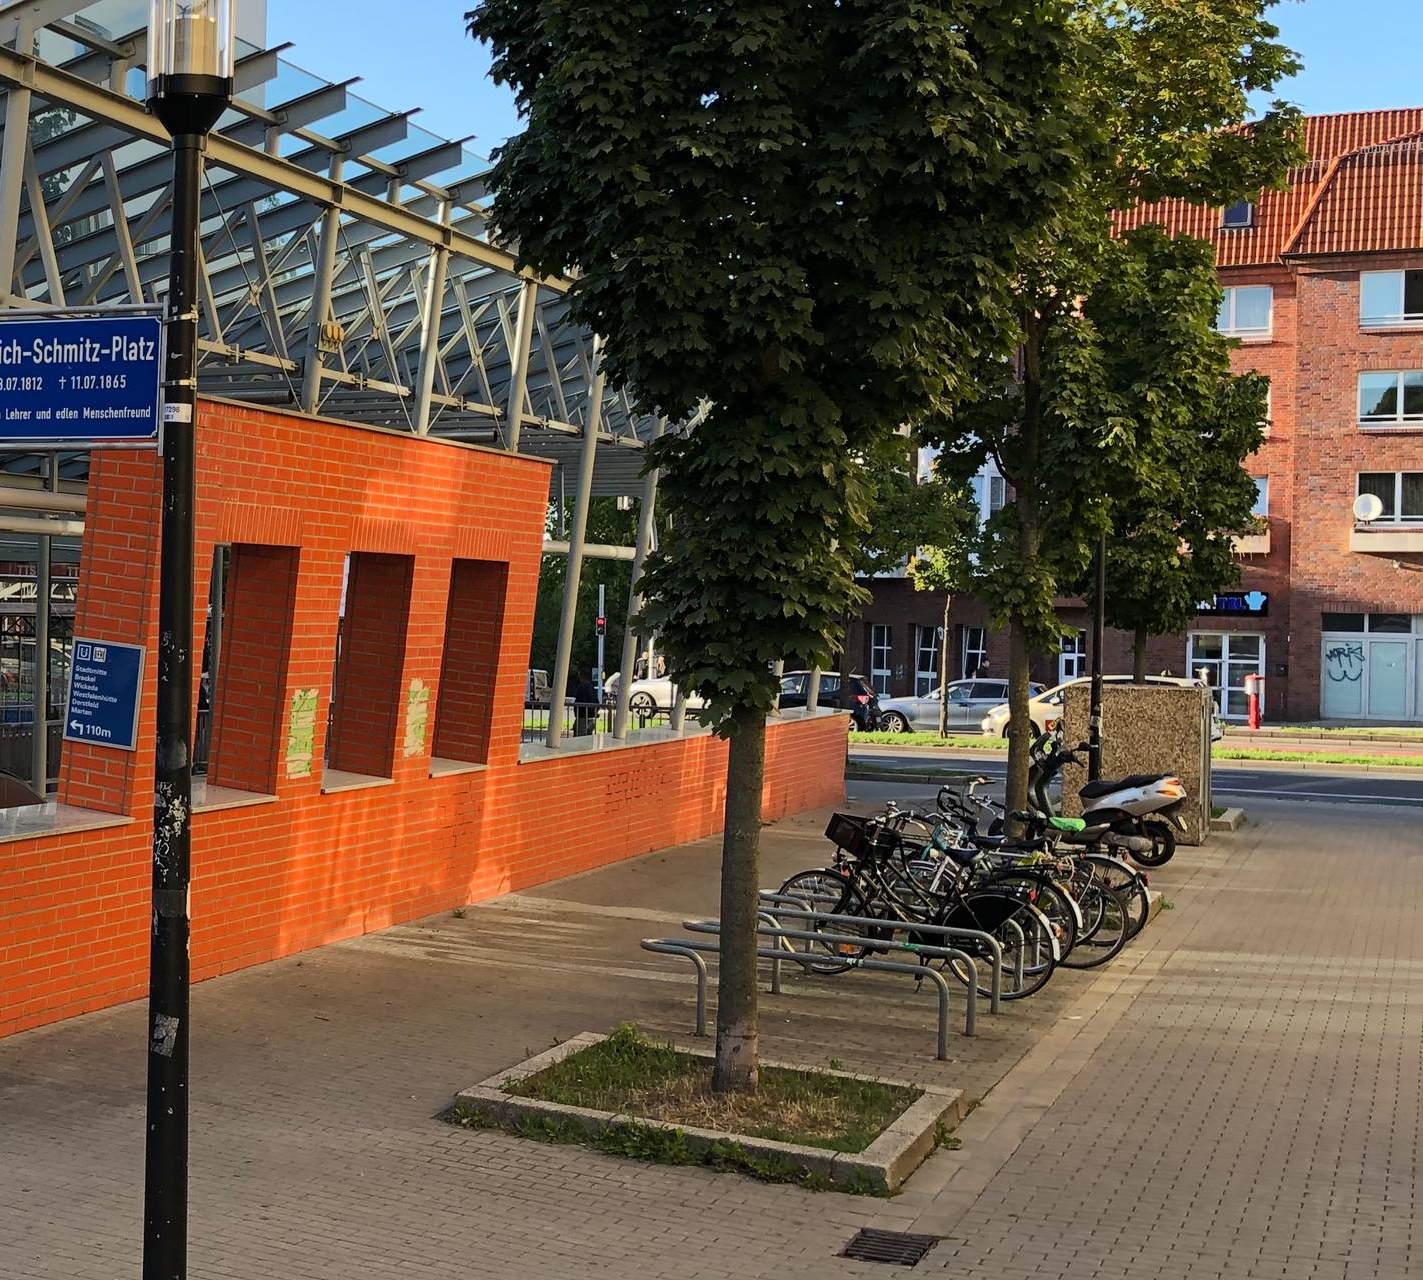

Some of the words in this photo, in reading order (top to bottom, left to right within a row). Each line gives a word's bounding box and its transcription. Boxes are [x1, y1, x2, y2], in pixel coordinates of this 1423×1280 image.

[71, 375, 126, 390] 11.07.1865
[5, 408, 32, 420] Lehrer
[36, 407, 51, 419] und
[55, 407, 78, 419] edlen
[83, 406, 151, 419] Menschenfreund
[75, 665, 108, 676] Stadtmitte
[74, 674, 97, 682] Brackel
[73, 682, 99, 691] Wickede
[72, 690, 118, 703] Westfalenhütte
[72, 699, 99, 709] Dorstfeld
[71, 707, 93, 716] Marten
[85, 724, 112, 738] 110m
